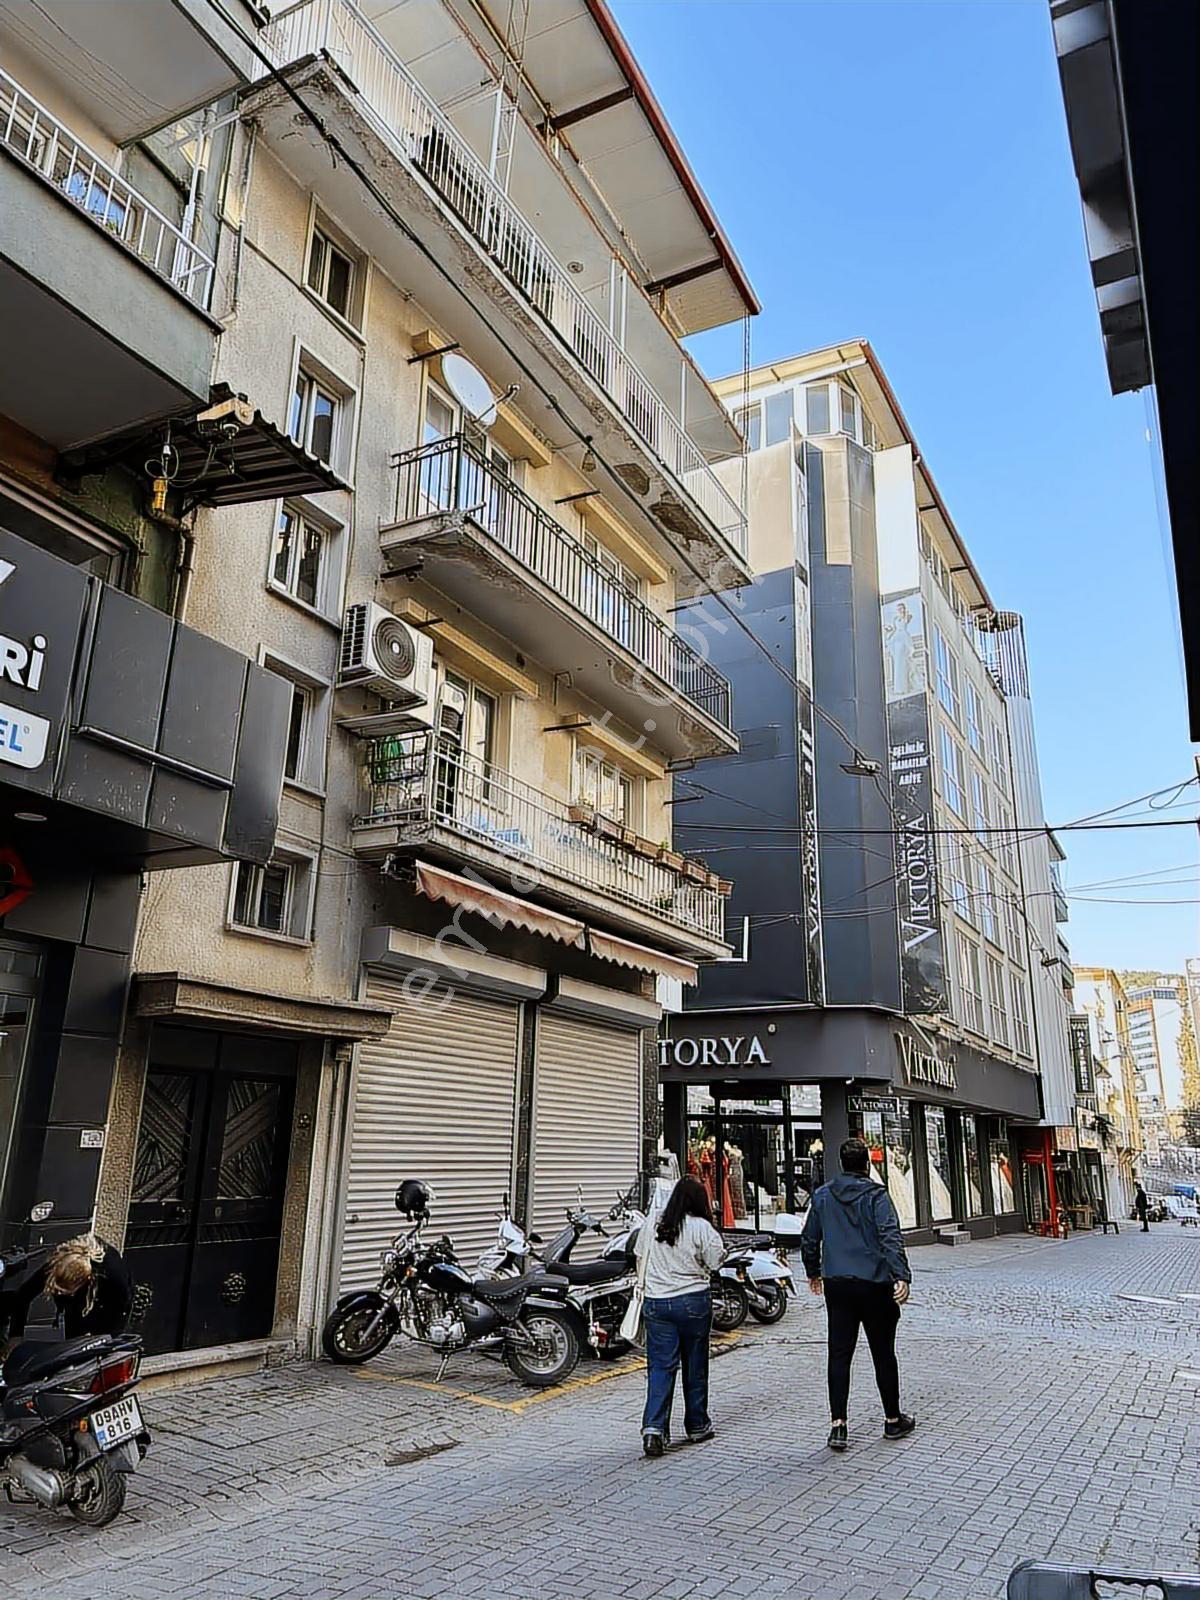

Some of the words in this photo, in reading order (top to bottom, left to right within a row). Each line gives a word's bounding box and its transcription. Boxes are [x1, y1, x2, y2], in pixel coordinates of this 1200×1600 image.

[0, 632, 46, 691] Ri
[658, 1035, 771, 1066] TORYA
[95, 1399, 133, 1427] 09AHV
[107, 1418, 131, 1438] 816
